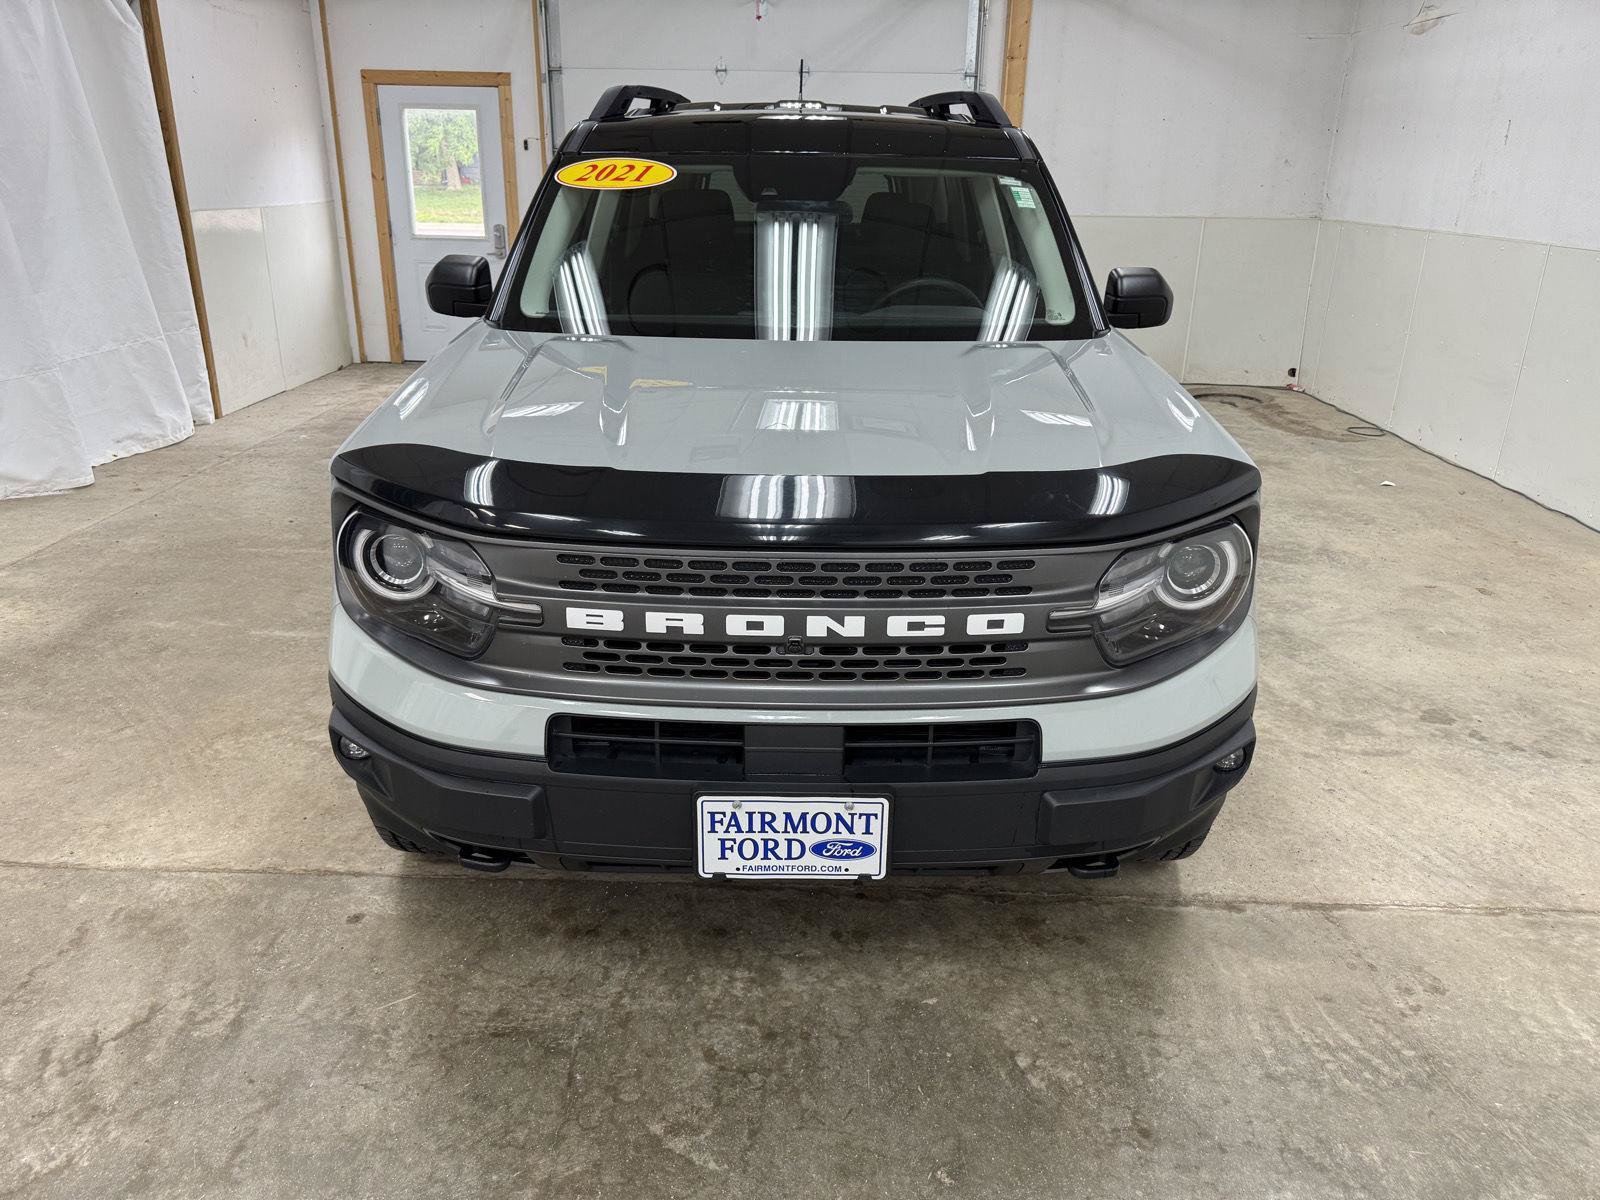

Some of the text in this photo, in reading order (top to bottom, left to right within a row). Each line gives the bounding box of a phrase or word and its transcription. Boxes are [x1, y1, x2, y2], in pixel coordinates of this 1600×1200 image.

[574, 164, 654, 182] 2021
[566, 607, 1025, 636] BRONCO
[707, 811, 879, 835] FAIRMONT
[717, 838, 806, 861] FORD
[823, 841, 863, 857] Ford
[742, 865, 842, 873] FAIRMONTFORD.COM
